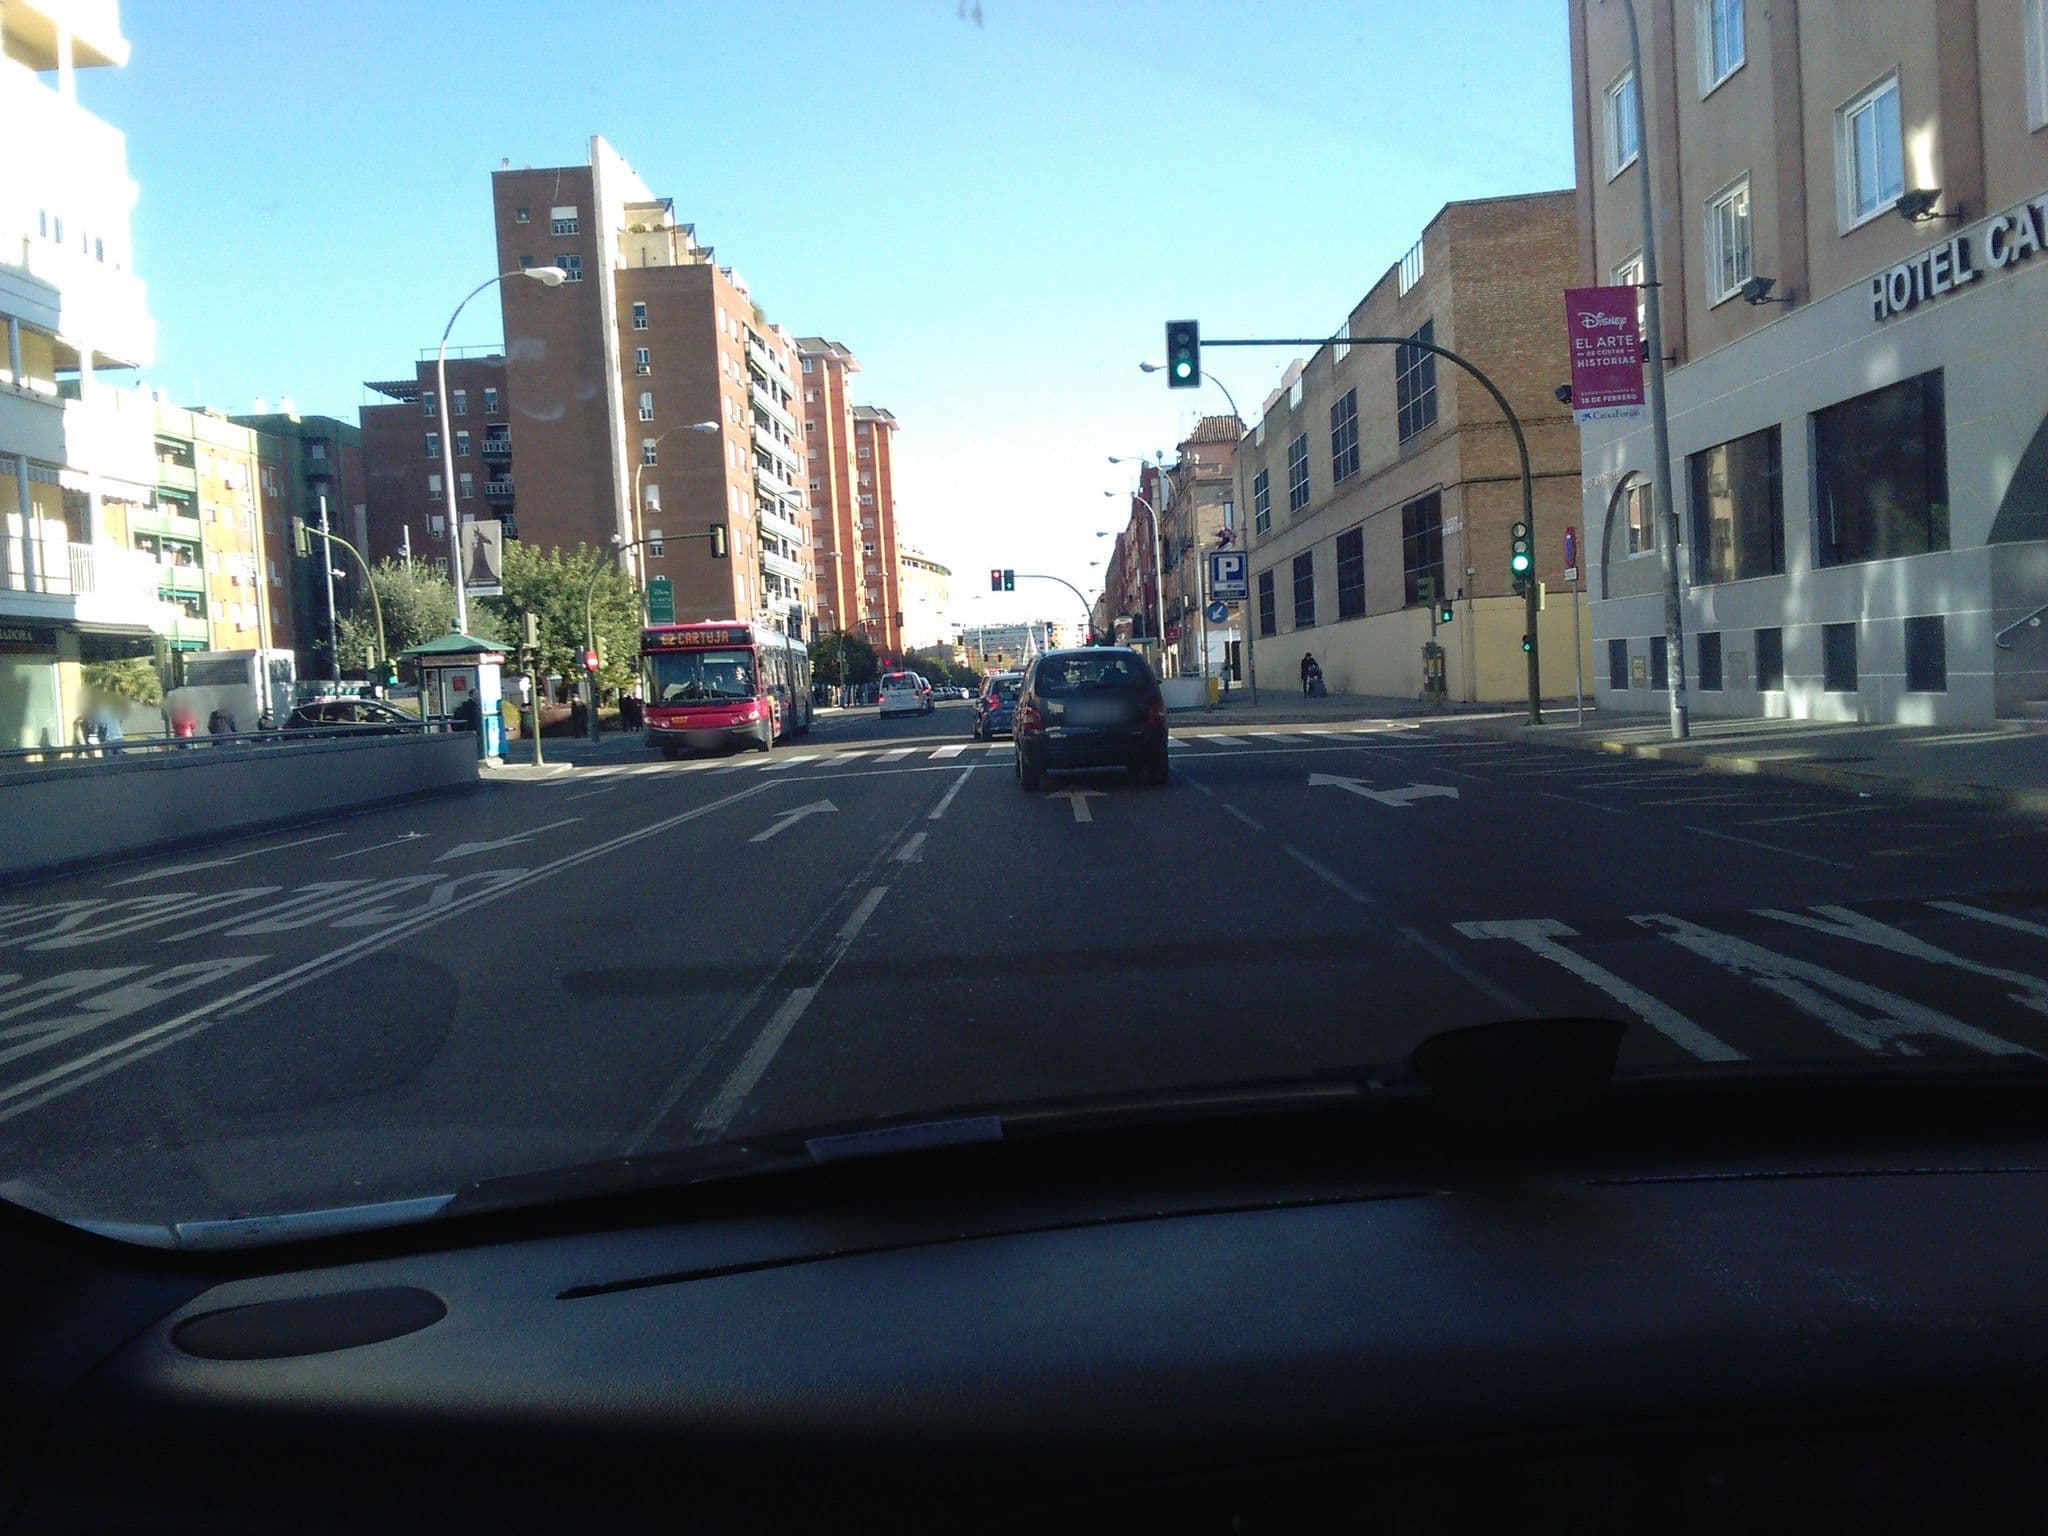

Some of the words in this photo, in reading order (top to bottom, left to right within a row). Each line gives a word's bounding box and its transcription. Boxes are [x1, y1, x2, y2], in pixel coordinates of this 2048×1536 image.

[1871, 237, 1973, 320] HOTEL
[1578, 312, 1627, 330] Disney
[1576, 338, 1593, 349] EL
[1596, 334, 1634, 347] ARTE
[1577, 355, 1636, 368] HISTORIAS
[1218, 557, 1240, 581] P
[678, 630, 729, 645] CARTUJA
